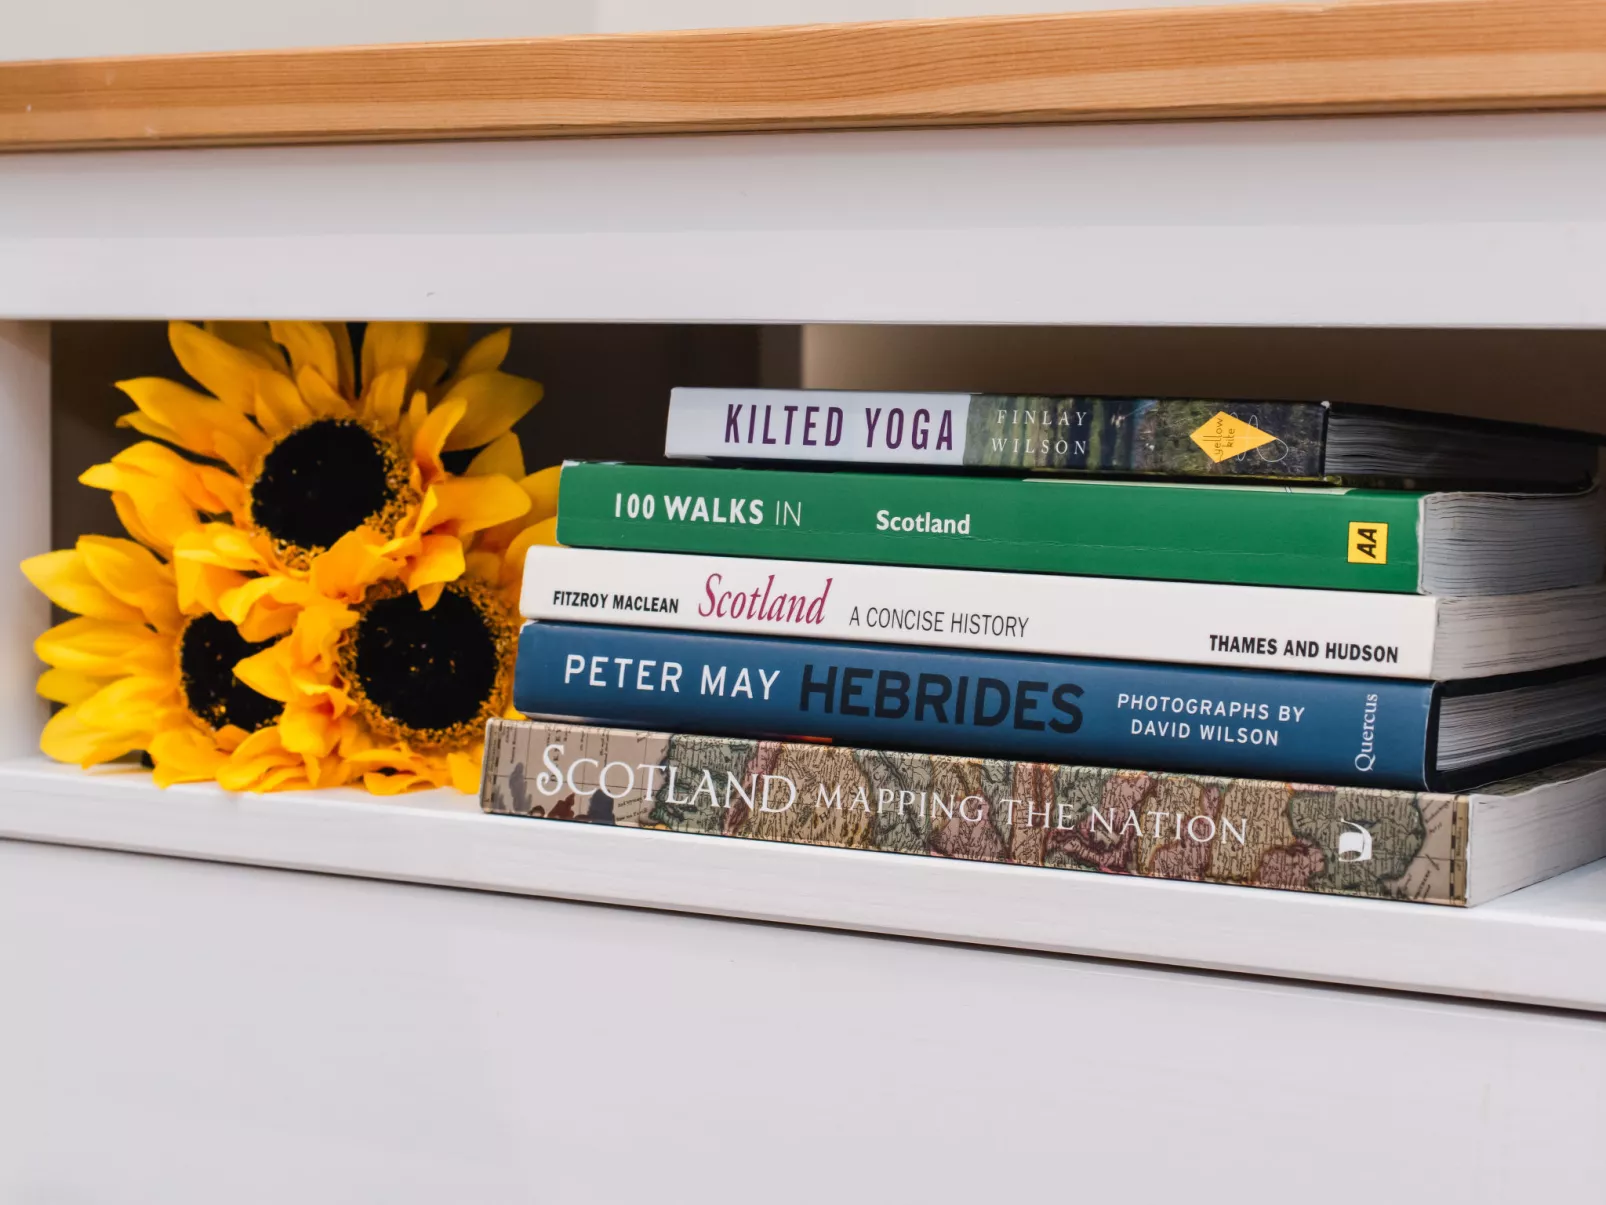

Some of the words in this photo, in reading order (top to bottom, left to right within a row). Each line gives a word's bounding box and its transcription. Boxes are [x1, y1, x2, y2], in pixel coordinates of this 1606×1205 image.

[724, 403, 844, 446] KILTED
[865, 407, 953, 451] YOGA
[997, 409, 1088, 426] FINLAY
[991, 437, 1087, 455] WILSON
[1203, 418, 1224, 457] yellow
[1222, 428, 1236, 448] kite
[615, 493, 655, 519] 100
[664, 495, 764, 525] WALKS
[775, 500, 802, 527] IN
[876, 510, 971, 534] Scotland
[1356, 528, 1378, 559] AA
[553, 590, 609, 609] FITZROY
[612, 595, 679, 614] MACLEAN
[698, 573, 833, 625] Scotland
[849, 606, 860, 627] A
[866, 607, 945, 633] CONCISE
[951, 611, 1029, 638] HISTORY
[1210, 634, 1277, 656] THAMES
[1283, 639, 1319, 658] AND
[1326, 642, 1399, 664] HUDSON
[564, 654, 683, 693] PETER
[700, 664, 780, 700] MAY
[800, 664, 1085, 734] HEBRIDES
[1117, 693, 1269, 720] PHOTOGRAPHS
[1278, 705, 1306, 723] BY
[1131, 718, 1190, 739] DAVID
[1199, 724, 1279, 747] WILSON
[1354, 693, 1378, 772] Quercus
[536, 744, 797, 813] SCOTLAND
[815, 783, 987, 823] MAPPING
[999, 798, 1075, 831] THE
[1090, 807, 1248, 846] NATION
